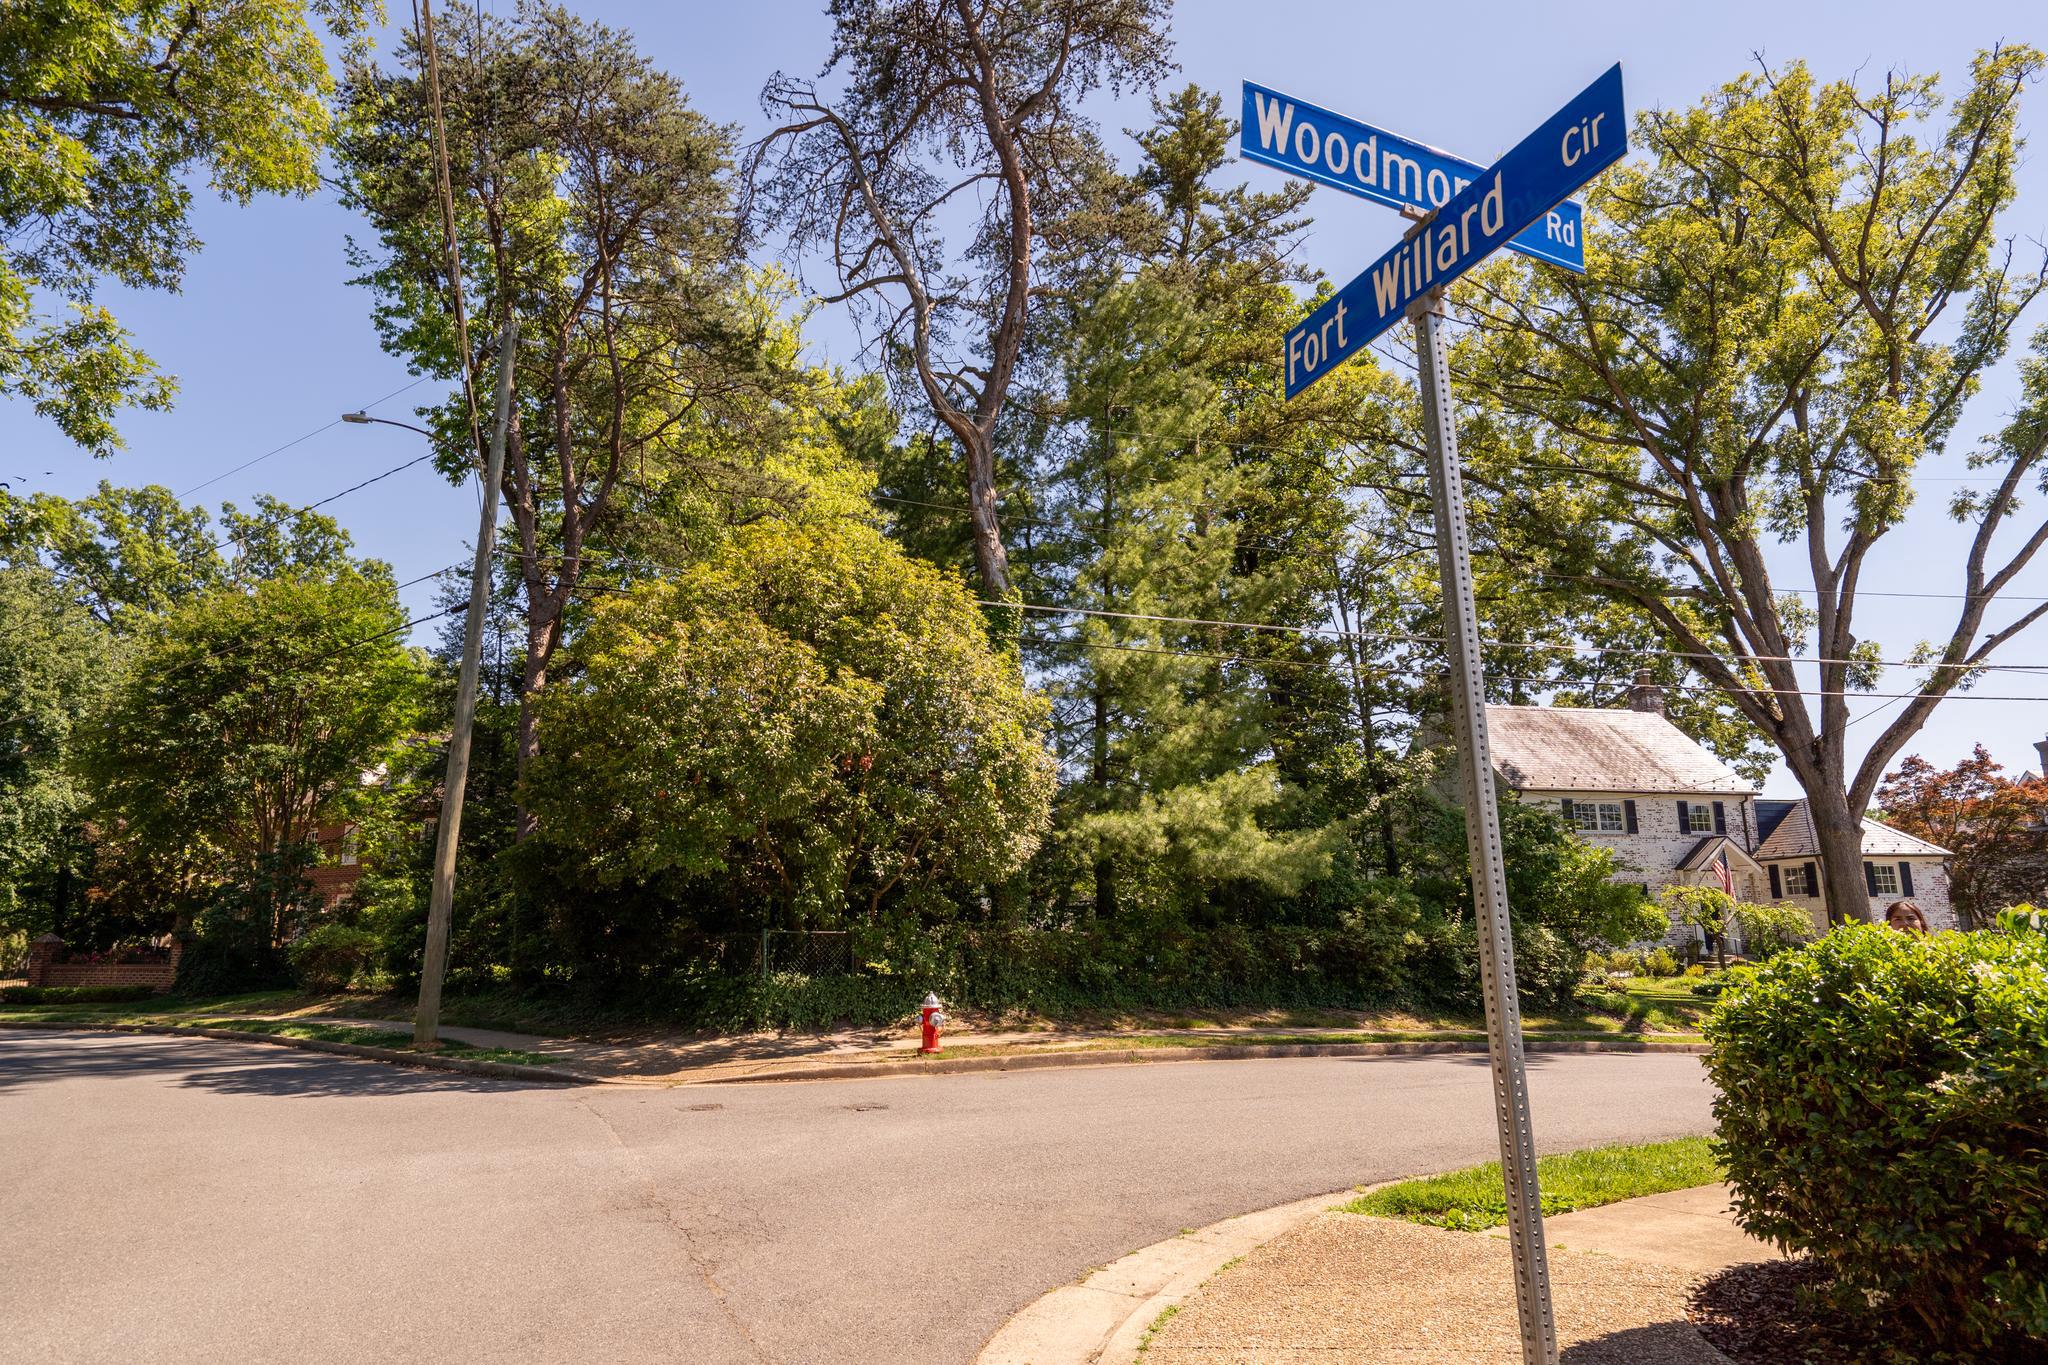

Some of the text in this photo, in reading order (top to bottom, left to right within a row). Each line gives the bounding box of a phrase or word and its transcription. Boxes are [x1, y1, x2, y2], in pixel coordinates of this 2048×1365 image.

[1289, 112, 1605, 385] Fort Willard Cir
[1547, 212, 1575, 247] Rd
